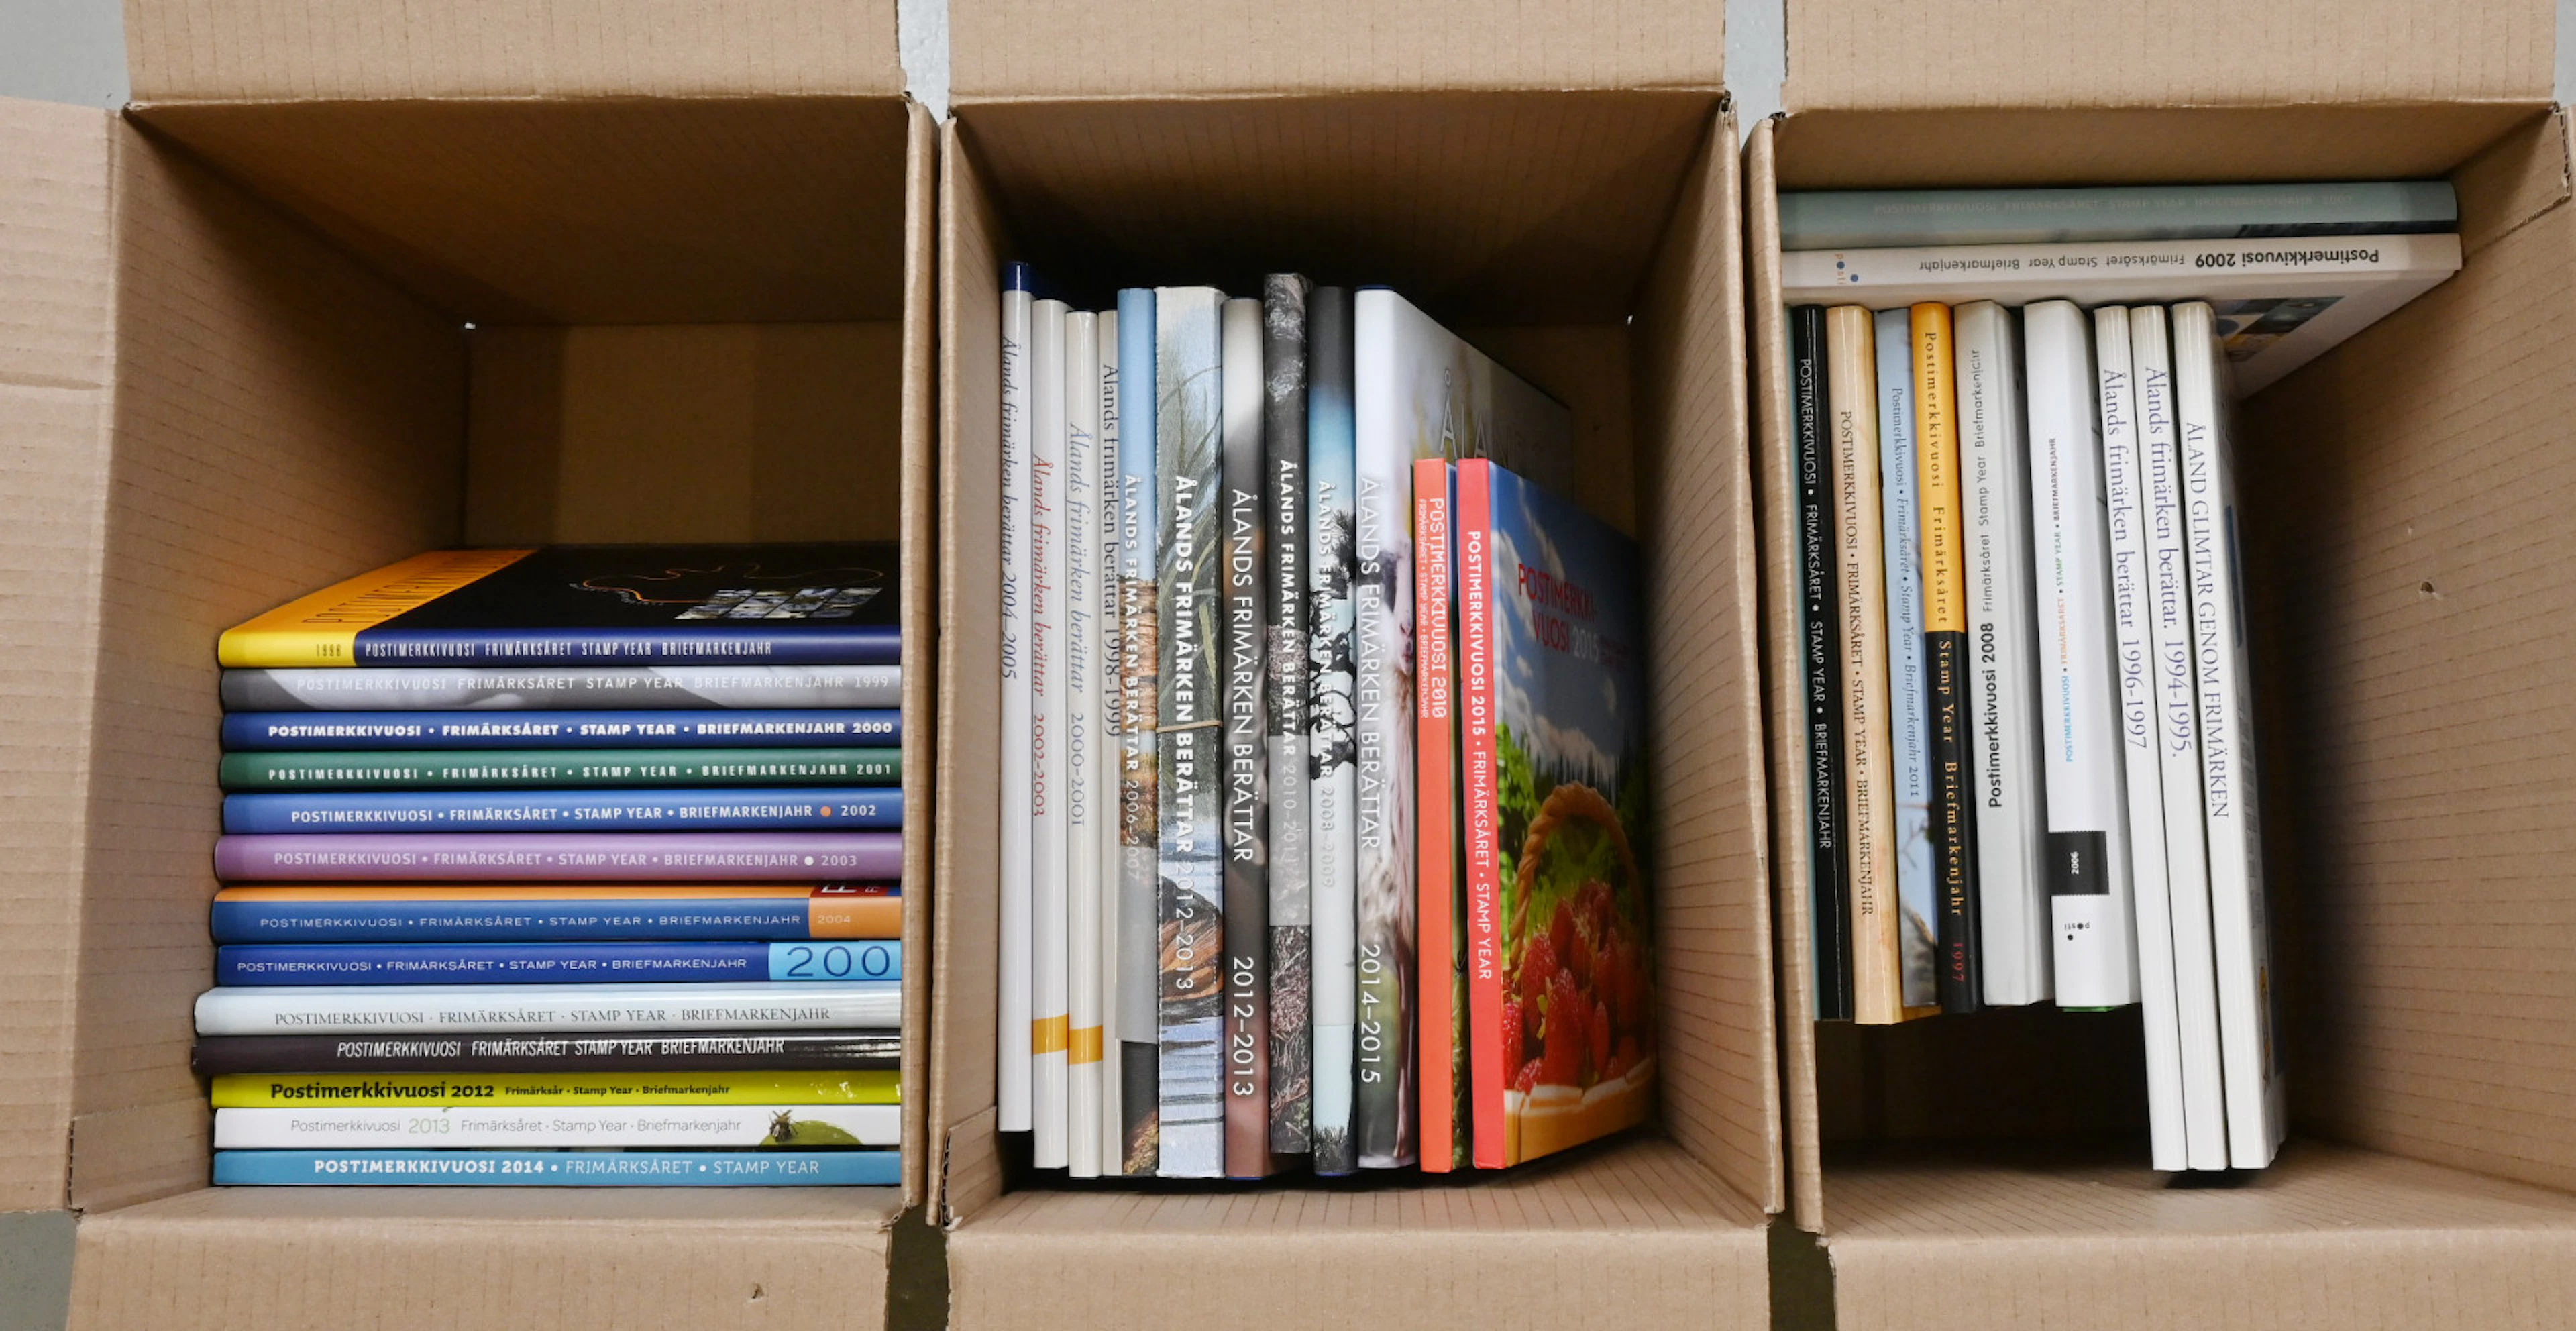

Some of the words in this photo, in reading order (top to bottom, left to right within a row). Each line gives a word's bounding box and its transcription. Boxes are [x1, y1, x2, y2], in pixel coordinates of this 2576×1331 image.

[1920, 258, 2020, 270] Briefmarkenjahr
[2029, 258, 2055, 268] Year
[2059, 257, 2098, 268] Stamp
[2106, 254, 2185, 266] Frimärksåret
[2196, 252, 2235, 267] 2009
[2243, 249, 2378, 265] Postimerkkivuosi
[1800, 358, 1815, 485] POSTIMERKKIVUOSI
[1892, 388, 1907, 486] Postimerkkivuosi
[1925, 331, 1941, 488] Postimerkkivuosi
[2104, 369, 2127, 435] Ålands
[2146, 367, 2169, 434] Ålands
[1033, 455, 1053, 517] Ålands
[1070, 423, 1093, 493] Ålands
[1841, 411, 1858, 549] POSTIMERKKIVUOSI
[2110, 444, 2133, 541] frimärken
[2151, 443, 2176, 539] frimärken
[2187, 423, 2206, 493] ÅLAND
[1125, 474, 1142, 550] ÅLANDS
[1176, 476, 1197, 571] ÅLANDS
[1281, 460, 1297, 533] ÅLANDS
[1318, 480, 1335, 556] ÅLANDS
[1360, 477, 1383, 574] ÅLANDS
[1032, 521, 1051, 615] frimärken
[1067, 498, 1091, 602] frimärken
[1233, 489, 1257, 586] ÅLANDS
[1806, 504, 1825, 600] FRIMÄRKSÅRET
[1933, 507, 1948, 622] Frimärksåret
[1980, 535, 1993, 612] Frimärksåret
[2192, 501, 2213, 596] GLIMTAR
[1124, 558, 1142, 668] FRIMÄRKEN
[1281, 543, 1298, 652] FRIMÄRKEN
[1319, 566, 1337, 673] FRIMÄRKEN
[1430, 498, 1446, 671] POSTIMERKKIVUOSI
[1468, 531, 1485, 690] POSTIMERKKIVUOSI
[1847, 563, 1862, 667] FRIMÄRKSÅRET
[2116, 551, 2136, 627] berättar
[2159, 548, 2179, 629] berättar.
[366, 643, 475, 657] POSTIMERKKIVUOSI
[485, 641, 571, 657] FRIMÄRKSÅRET
[582, 642, 619, 656] STAMP
[624, 642, 651, 656] YEAR
[662, 641, 771, 655] BRIEFMARKENJAHR
[1033, 623, 1051, 696] berättar
[1070, 610, 1091, 693] berättar
[1176, 582, 1197, 721] FRIMÄRKEN
[1233, 596, 1258, 733] FRIMÄRKEN
[1362, 584, 1385, 721] FRIMÄRKEN
[1811, 621, 1825, 663] STAMP
[1938, 641, 1952, 695] Stamp
[1981, 623, 1995, 663] 2008
[2199, 602, 2219, 684] GENOM
[297, 678, 446, 691] POSTIMERKKIVUOSI
[458, 675, 573, 690] FRIMÄRKSÅRET
[586, 676, 637, 689] STAMP
[643, 676, 682, 689] YEAR
[694, 676, 843, 689] BRIEFMARKENJAHR
[855, 676, 889, 688] 1999
[1282, 662, 1299, 756] BERÄTTAR
[1432, 677, 1446, 718] 2010
[1472, 697, 1486, 735] 2015
[1813, 666, 1825, 702] YEAR
[1851, 680, 1865, 725] STAMP
[2123, 640, 2147, 749] 1996-1997
[269, 725, 420, 737] POSTIMERKKIVUOSI
[442, 722, 559, 736] FRIMÄRKSÅRET
[580, 724, 631, 735] STAMP
[637, 724, 676, 735] YEAR
[697, 723, 845, 735] BRIEFMARKENJAHR
[853, 723, 892, 733] 2000
[1126, 677, 1142, 769] BERÄTTAR
[1319, 683, 1336, 778] BERÄTTAR
[1855, 730, 1866, 767] YEAR
[1941, 704, 1955, 742] Year
[1981, 670, 2002, 808] Postimerkkivuosi
[2205, 693, 2229, 818] FRIMÄRKEN
[269, 768, 417, 780] POSTIMERKKIVUOSI
[443, 765, 556, 778] FRIMÄRKSÅRET
[583, 766, 631, 778] STAMP
[640, 765, 676, 777] YEAR
[702, 764, 847, 776] BRIEFMARKENJAHR
[857, 764, 891, 775] 2001
[1176, 733, 1197, 853] BERÄTTAR
[1234, 745, 1258, 861] BERÄTTAR
[1362, 732, 1385, 849] BERÄTTAR
[1472, 751, 1489, 867] FRIMÄRKSÅRET
[1815, 723, 1831, 849] BRIEFMARKENJAHR
[292, 810, 433, 823] POSTIMERKKIVUOSI
[450, 806, 557, 820] FRIMÄRKSÅRET
[575, 808, 621, 819] STAMP
[627, 807, 661, 818] YEAR
[680, 806, 812, 819] BRIEFMARKENJAHR
[841, 805, 876, 816] 2002
[1857, 780, 1874, 916] BRIEFMARKENJAHR
[1945, 761, 1964, 916] Briefmarkenjahr
[274, 853, 416, 865] POSTIMERKKIVUOSI
[434, 850, 541, 865] FRIMÄRKSÅRET
[559, 854, 606, 865] STAMP
[611, 854, 646, 865] YEAR
[664, 854, 798, 867] BRIEFMARKENJAHR
[821, 855, 857, 866] 2003
[2070, 851, 2079, 874] 2006
[261, 919, 402, 928] POSTIMERKKIVUOSI
[420, 916, 531, 926] FRIMÄRKSÅRET
[549, 917, 597, 925] STAMP
[604, 917, 641, 925] YEAR
[659, 916, 800, 925] BRIEFMARKENJAHR
[818, 915, 851, 924] 2004
[1476, 883, 1491, 933] STAMP
[237, 962, 371, 971] POSTIMERKKIVUOSI
[387, 959, 494, 971] FRIMÄRKSÅRET
[509, 961, 555, 970] STAMP
[560, 960, 597, 969] YEAR
[612, 959, 747, 970] BRIEFMARKENJAHR
[786, 945, 891, 977] 200
[1478, 938, 1492, 979] YEAR
[275, 1012, 425, 1026] POSTIMERKKIVUOSI
[439, 1008, 555, 1024] FRIMÄRKSÅRET
[571, 1010, 621, 1022] STAMP
[627, 1009, 666, 1022] YEAR
[682, 1008, 830, 1022] BRIEFMARKENJAHR
[337, 1041, 461, 1057] POSTIMERKKIVUOSI
[471, 1037, 568, 1056] FRIMÄRKSÅRET
[575, 1040, 618, 1055] STAMP
[621, 1040, 652, 1055] YEAR
[661, 1039, 784, 1054] BRIEFMARKENJAHR
[270, 1081, 445, 1099] Postimerkkivuosi
[451, 1085, 494, 1098] 2012
[505, 1085, 563, 1095] Frimärksår
[574, 1086, 605, 1096] Stamp
[610, 1086, 632, 1094] Year
[643, 1085, 730, 1096] Briefmarkenjahr
[291, 1119, 400, 1132] Postimerkkivuosi
[409, 1118, 450, 1134] 2013
[462, 1118, 542, 1132] Frimärksåret
[553, 1119, 596, 1133] Stamp
[599, 1120, 627, 1131] Year
[637, 1118, 740, 1134] Briefmarkenjahr
[315, 1160, 495, 1173] POSTIMERKKIVUOSI
[502, 1160, 543, 1173] 2014
[566, 1159, 692, 1174] FRIMÄRKSÅRET
[714, 1161, 769, 1175] STAMP
[777, 1161, 819, 1175] YEAR
